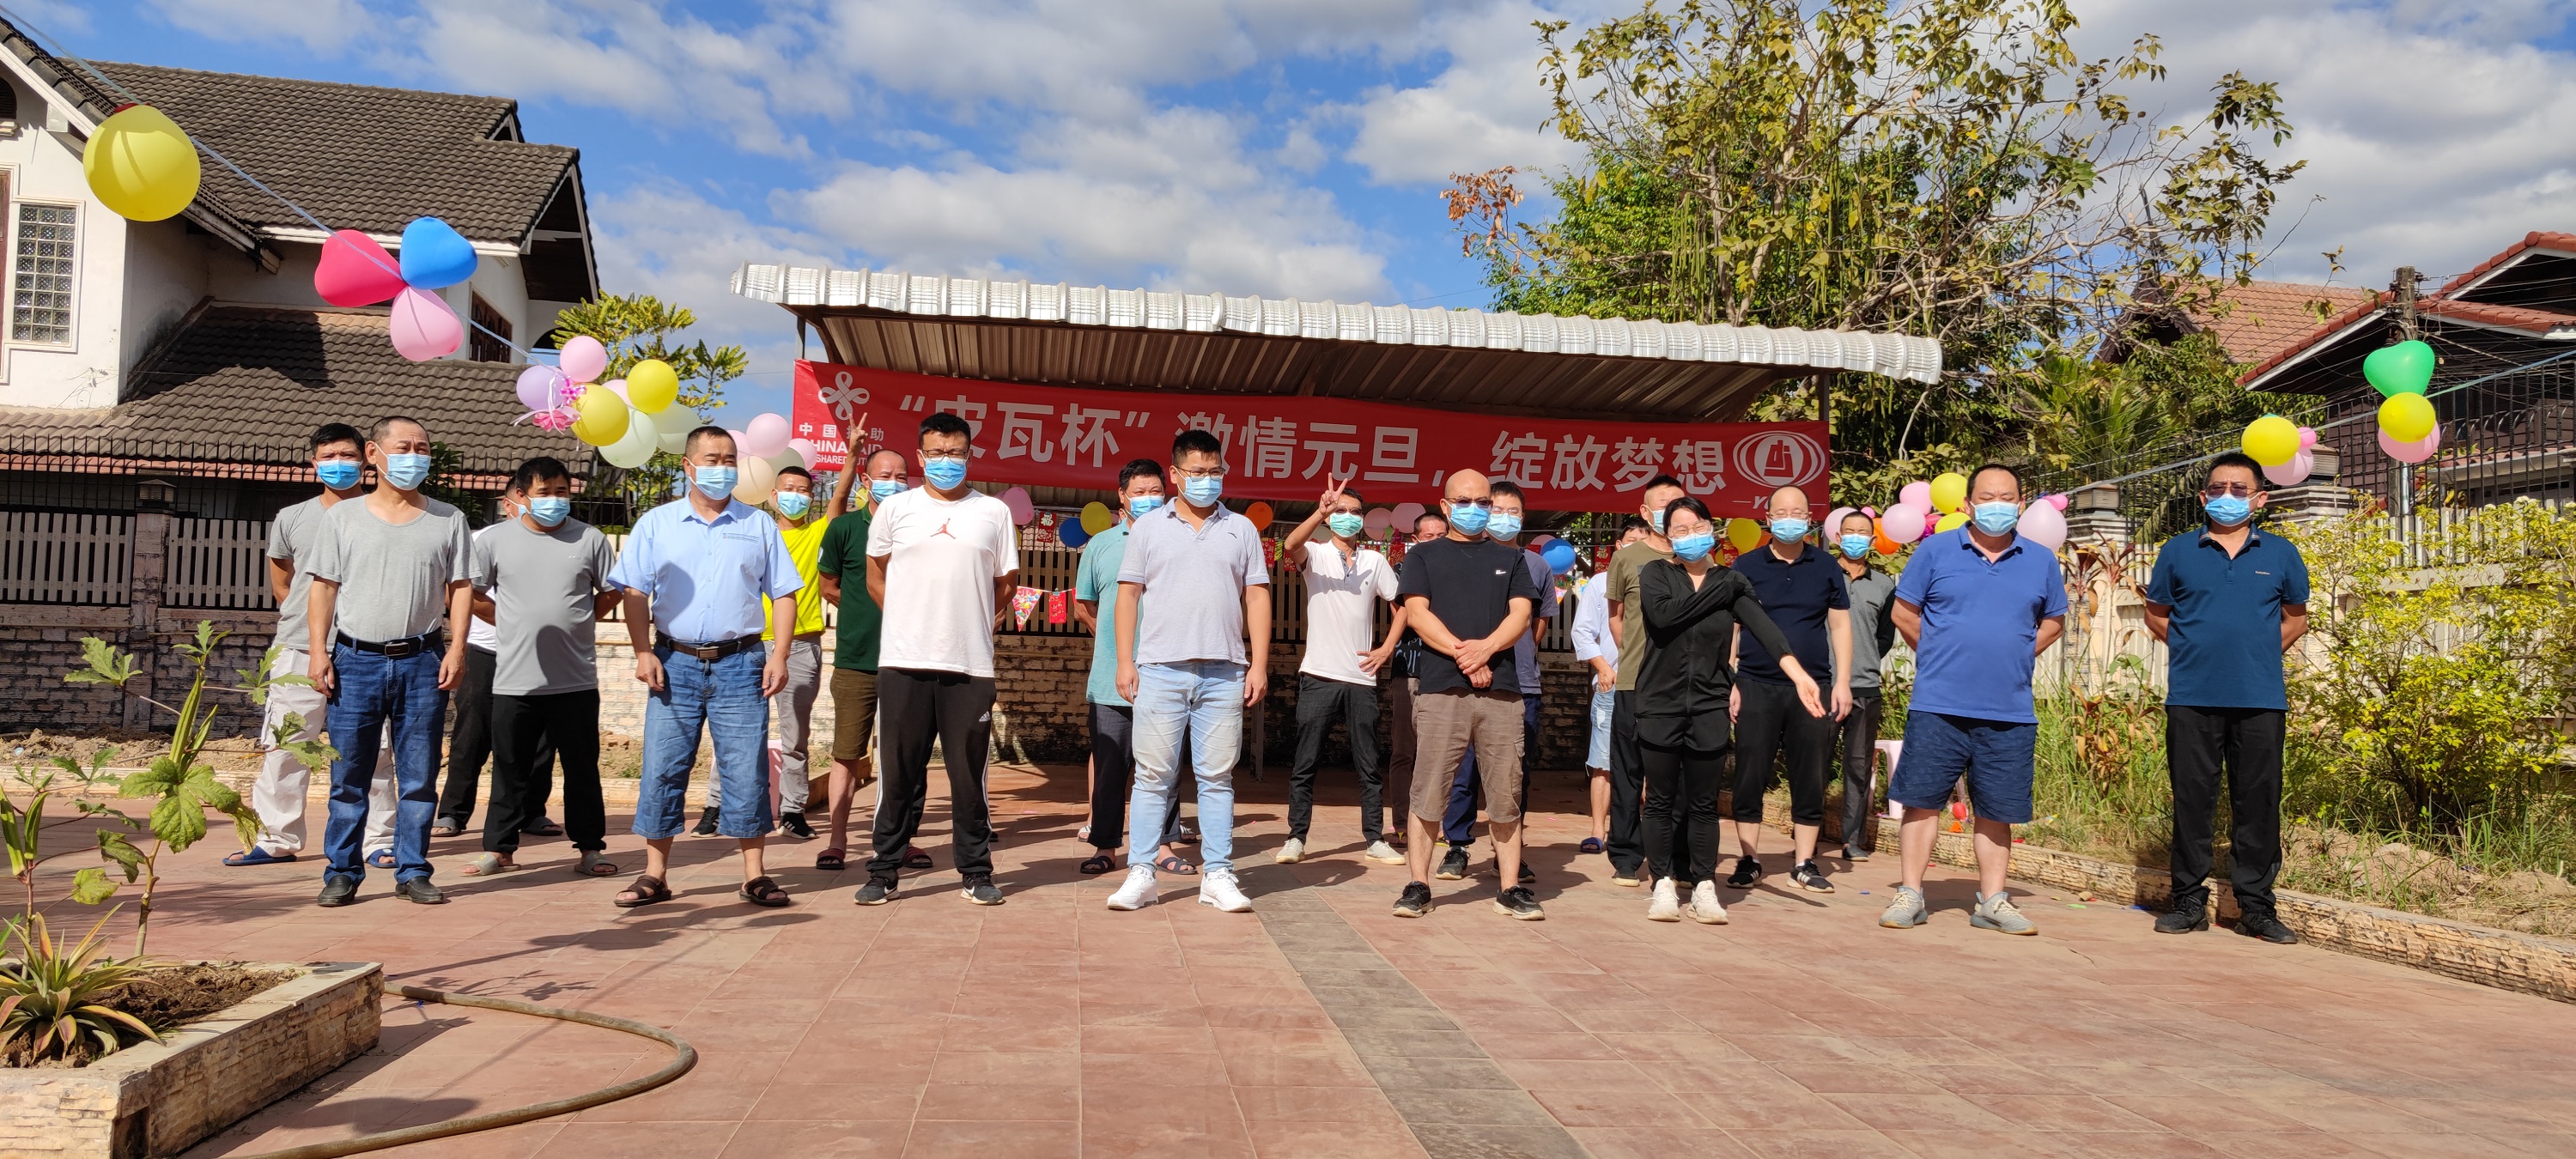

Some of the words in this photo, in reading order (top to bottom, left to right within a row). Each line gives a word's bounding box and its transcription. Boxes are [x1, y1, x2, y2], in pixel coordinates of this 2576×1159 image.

[799, 422, 884, 441] 中国助
[810, 439, 848, 454] HINA
